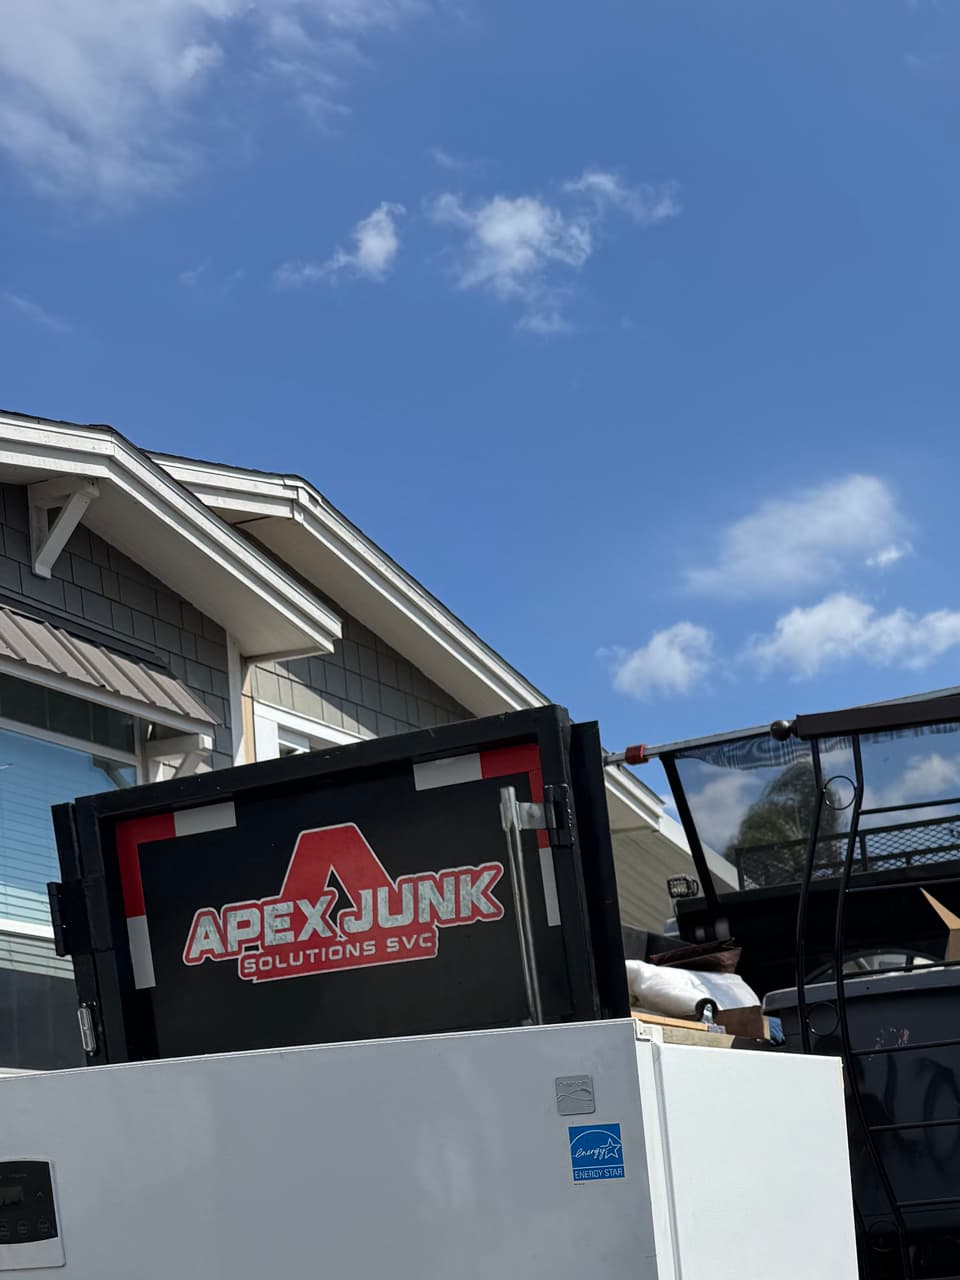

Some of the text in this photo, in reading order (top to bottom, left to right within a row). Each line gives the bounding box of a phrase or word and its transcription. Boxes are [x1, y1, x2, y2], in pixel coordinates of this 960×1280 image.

[188, 869, 499, 960] APEX JUNK
[243, 931, 434, 974] SOLUTIONS SVC
[574, 1167, 624, 1180] ENERGY STAR
